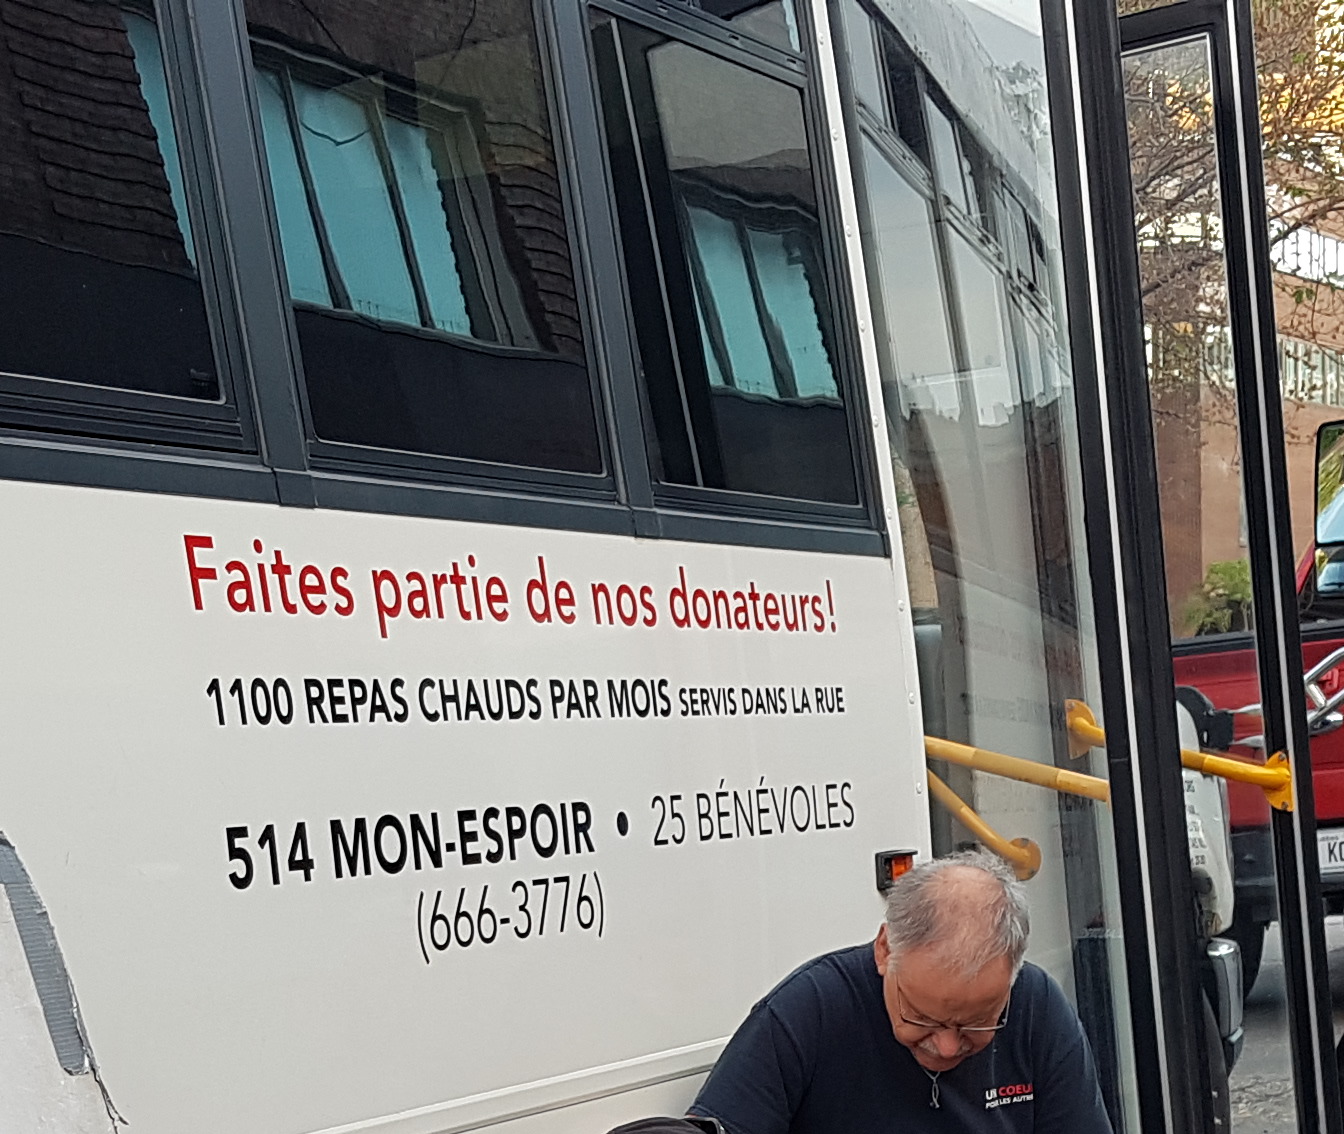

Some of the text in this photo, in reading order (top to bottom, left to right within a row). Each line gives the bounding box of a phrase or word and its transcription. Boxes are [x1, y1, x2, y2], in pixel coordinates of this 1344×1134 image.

[183, 534, 838, 639] Faites partie de nos donateurs!
[206, 677, 846, 726] 1100 REPAS CHAUDS PAR MOIS SERVIS DANS LA RUE
[225, 775, 855, 890] 514 MON-ESPOIR 25 BÉNÉVOLES
[416, 870, 605, 964] (666-3776)
[998, 1083, 1034, 1097] COEU
